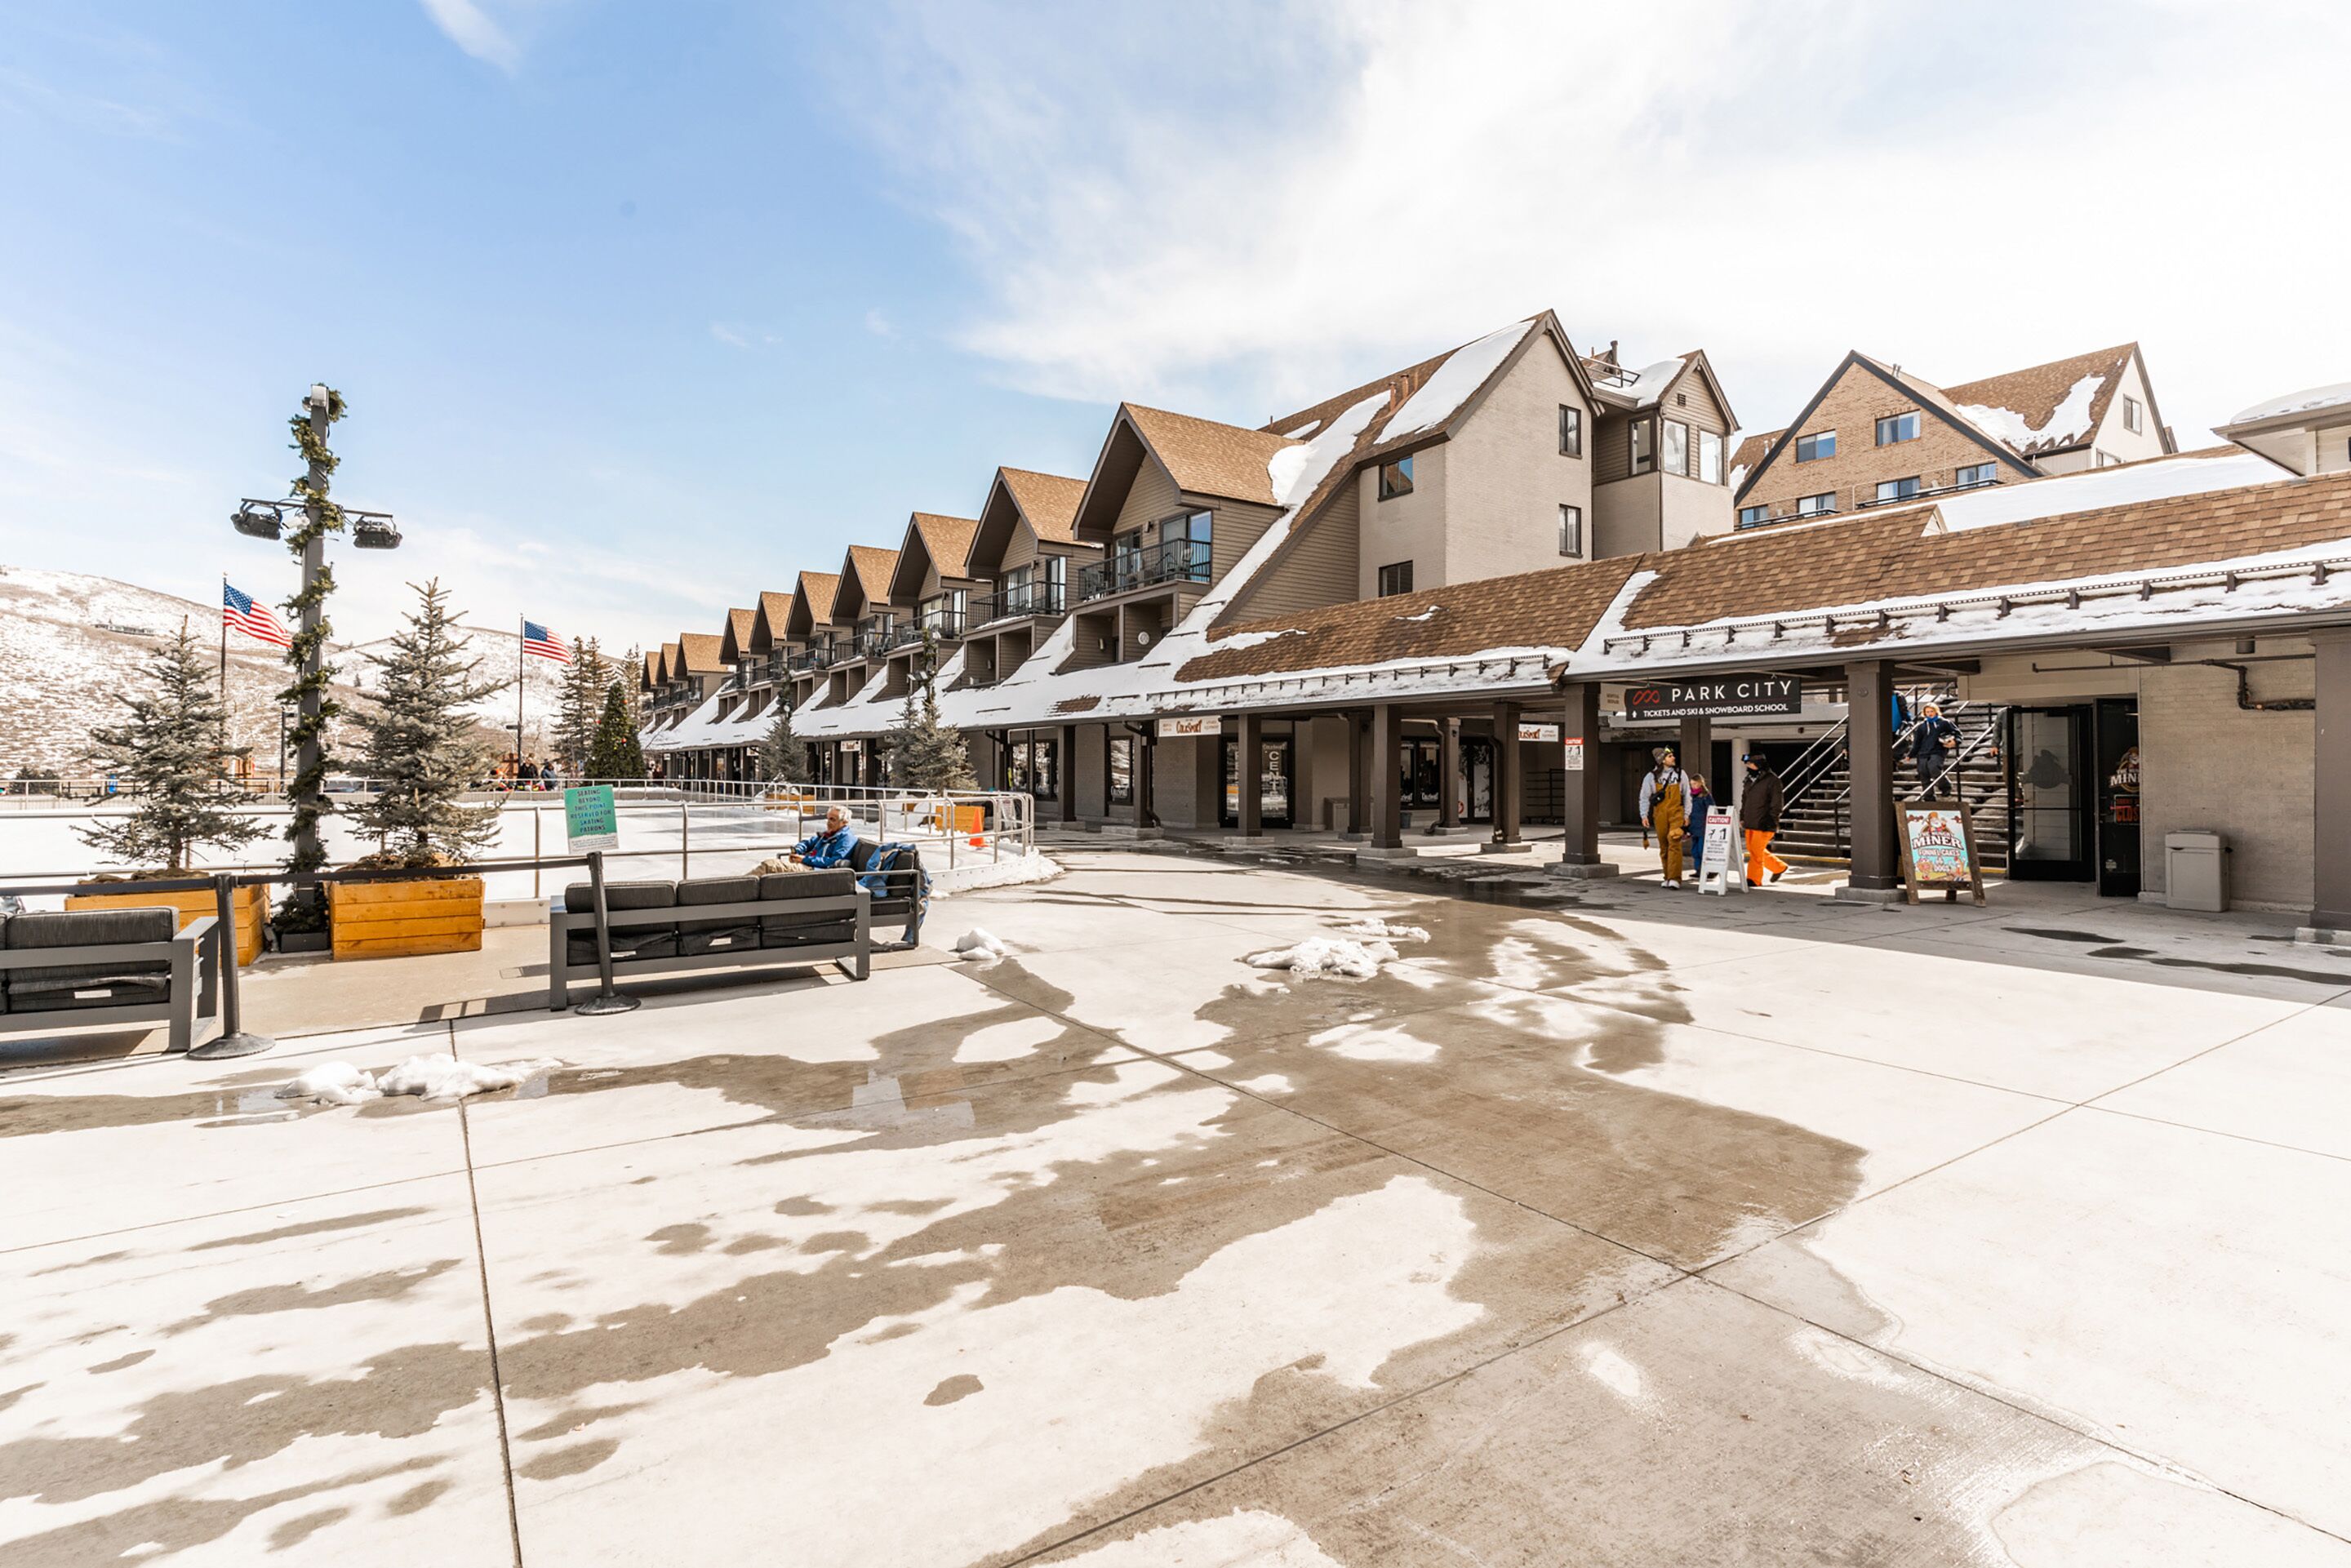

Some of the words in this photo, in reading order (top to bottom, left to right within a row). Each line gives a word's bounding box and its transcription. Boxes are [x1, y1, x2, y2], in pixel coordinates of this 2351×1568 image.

[1672, 685, 1725, 702] PARK
[1737, 680, 1792, 698] CITY
[1643, 708, 1670, 717] TICKETS
[1672, 708, 1687, 716] AND
[1687, 707, 1698, 716] SKI
[1699, 707, 1704, 715] &
[1704, 704, 1753, 714] SNOWBOARD
[1754, 703, 1789, 713] SCHOOL
[2109, 772, 2140, 786] MIN
[571, 811, 599, 819] RESERVED
[2116, 806, 2140, 823] CLOS
[580, 818, 604, 826] SKATING
[1912, 835, 1964, 851] MINER
